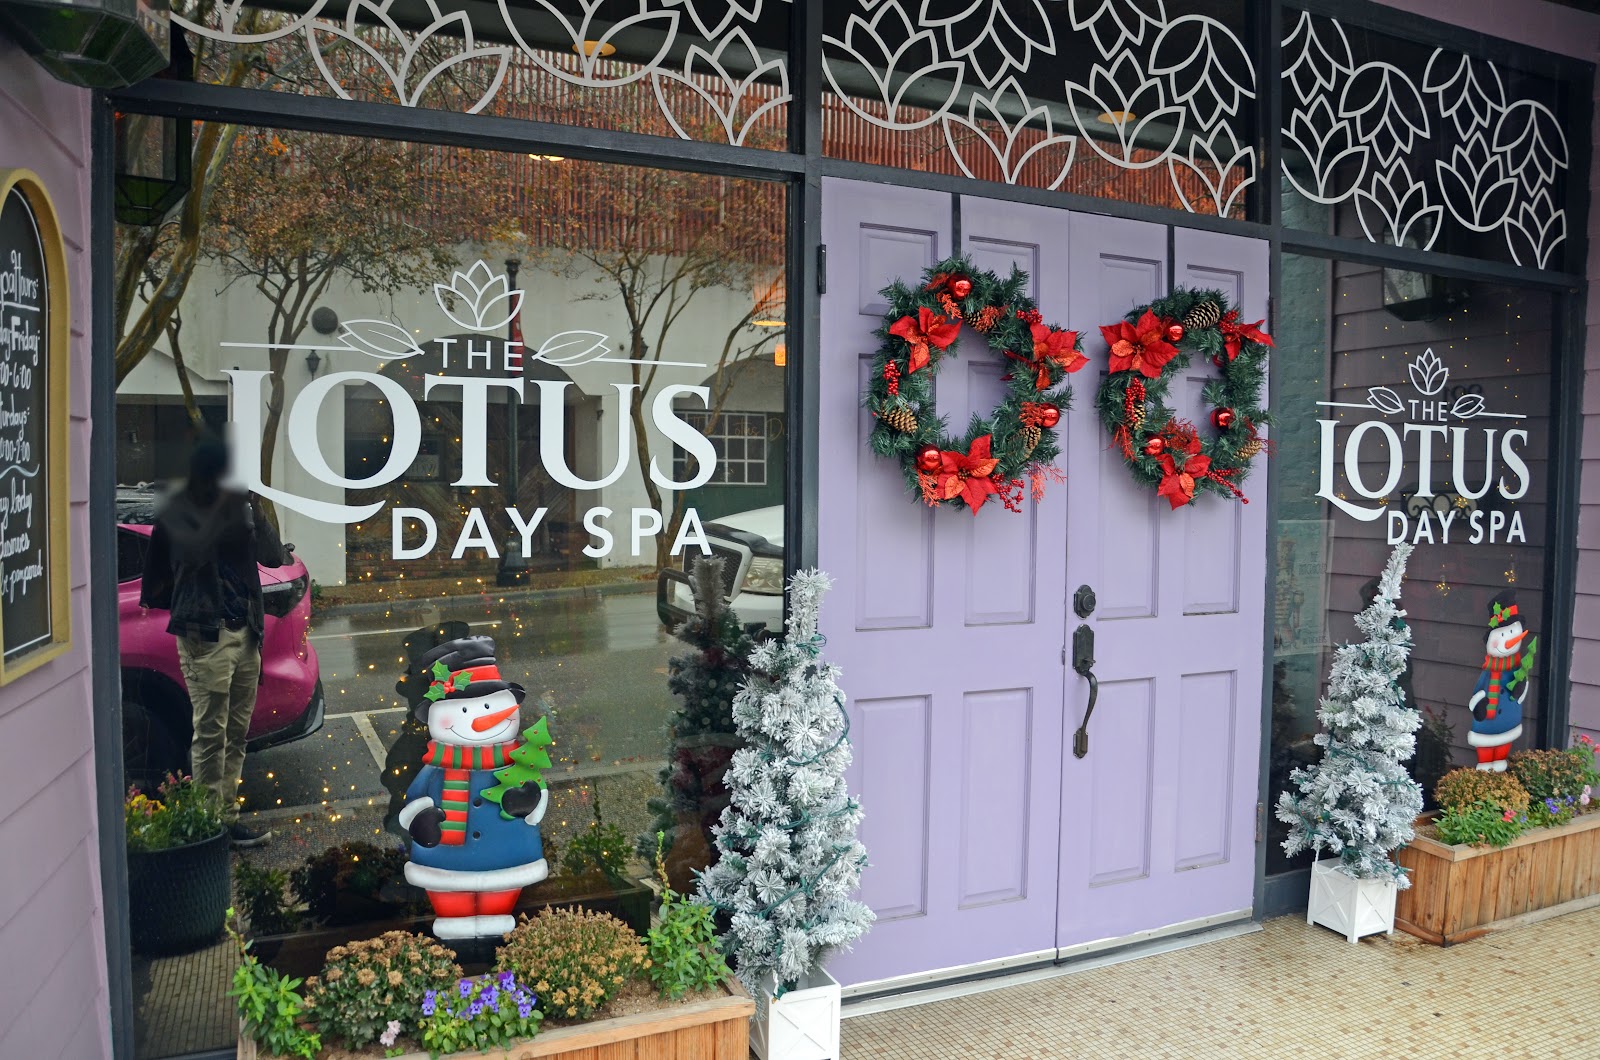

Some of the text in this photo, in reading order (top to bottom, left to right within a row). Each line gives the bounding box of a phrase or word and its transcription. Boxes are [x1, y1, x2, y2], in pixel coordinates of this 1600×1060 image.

[433, 337, 525, 372] THE
[1407, 399, 1448, 422] THE
[226, 369, 718, 525] LOTUS
[1314, 418, 1530, 522] LOTUS
[392, 506, 712, 561] DAY SPA
[1386, 510, 1527, 546] DAY SPA
